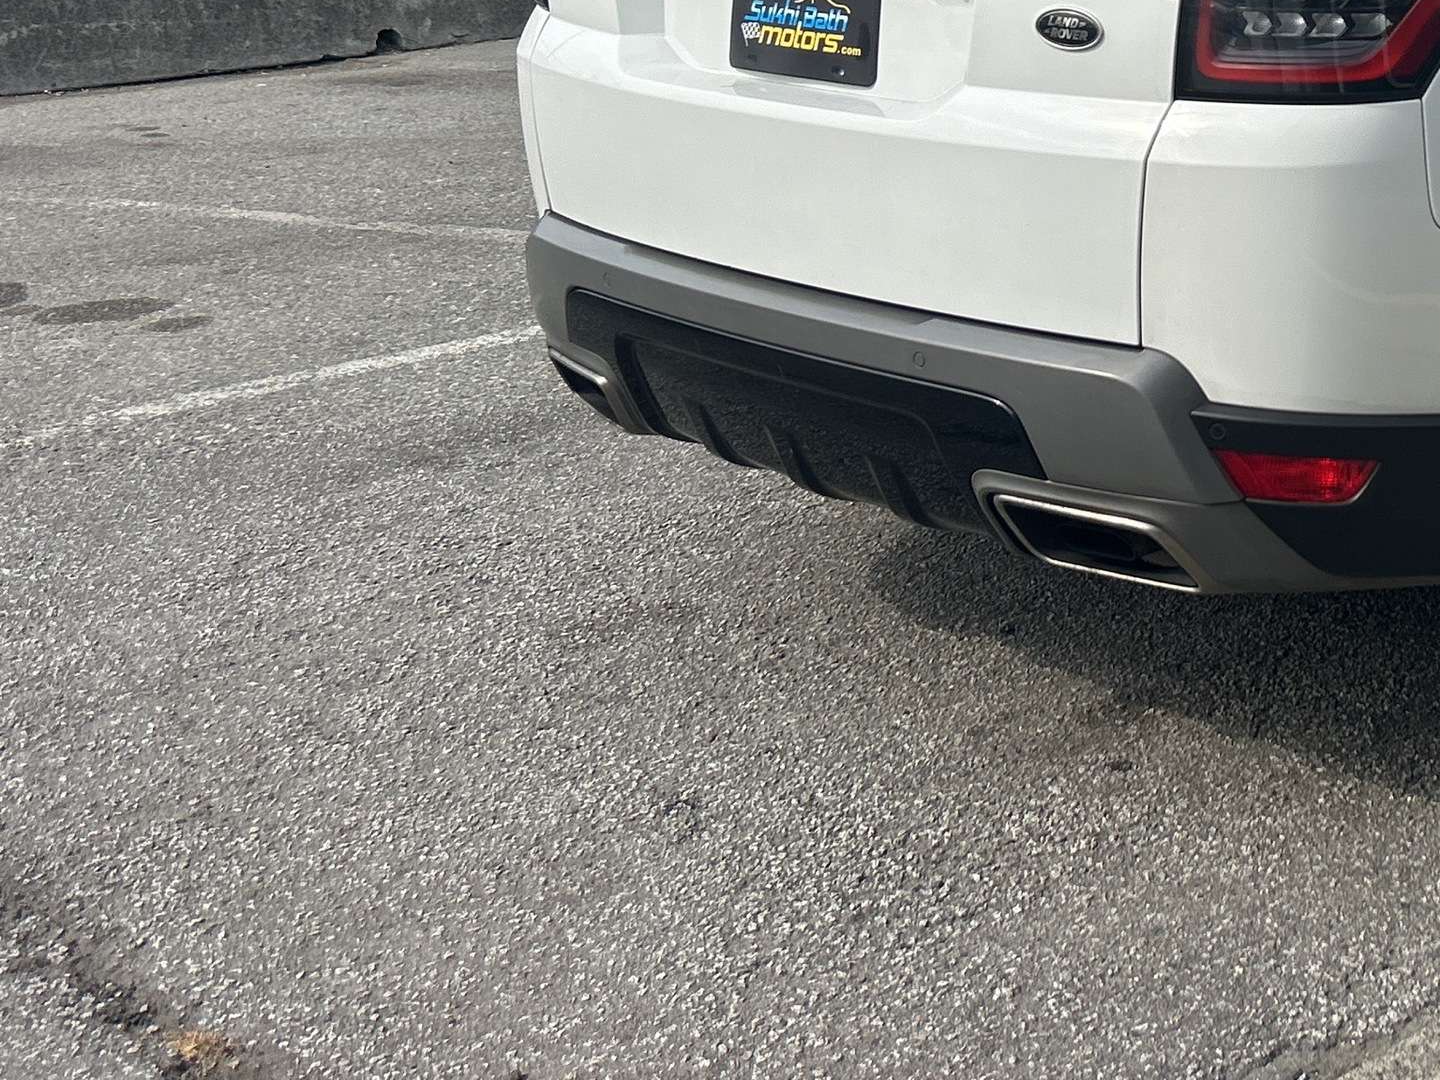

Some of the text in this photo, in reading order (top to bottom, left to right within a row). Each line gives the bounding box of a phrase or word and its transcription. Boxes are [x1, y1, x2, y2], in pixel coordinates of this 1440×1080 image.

[802, 6, 849, 32] Bath
[1048, 15, 1079, 28] LAND
[1050, 27, 1088, 41] ROVER
